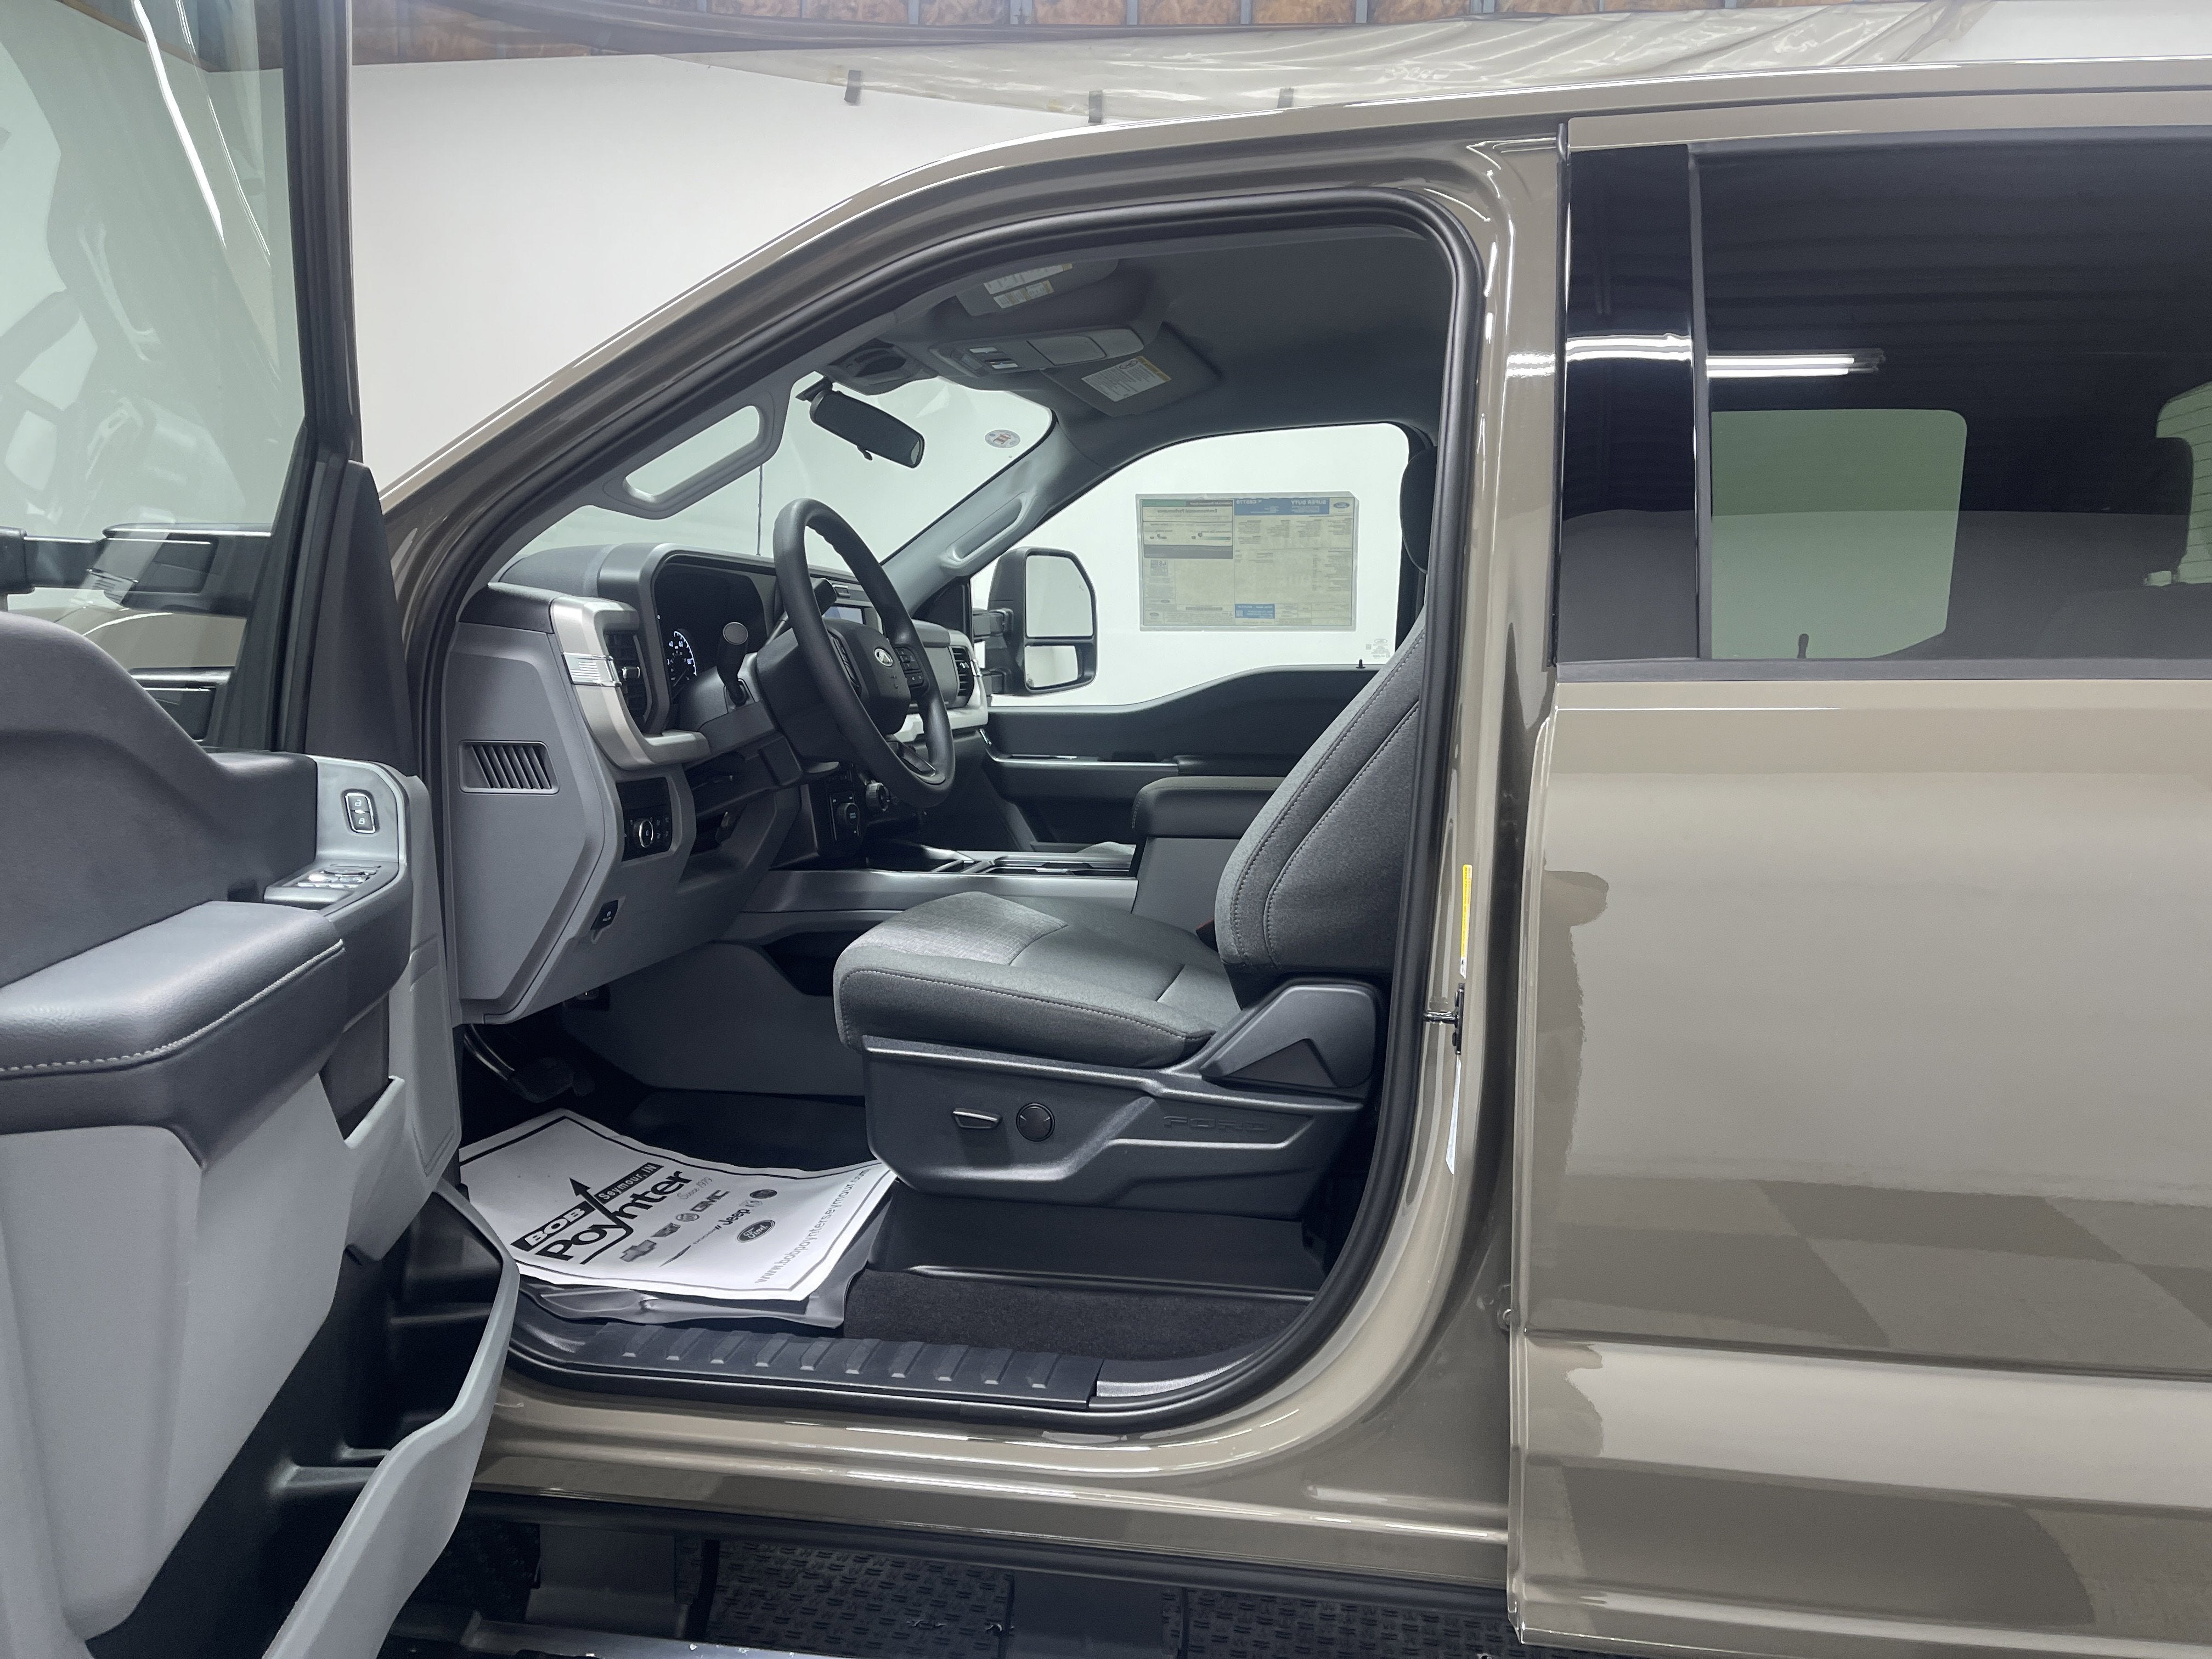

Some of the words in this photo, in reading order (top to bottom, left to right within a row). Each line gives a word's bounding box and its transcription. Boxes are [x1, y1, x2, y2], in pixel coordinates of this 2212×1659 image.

[599, 1172, 648, 1200] Seymour,
[643, 1164, 657, 1175] IN
[535, 1171, 692, 1265] Poynter
[689, 1190, 730, 1212] GMC
[718, 1209, 751, 1226] Jeep
[524, 1208, 586, 1246] BOB
